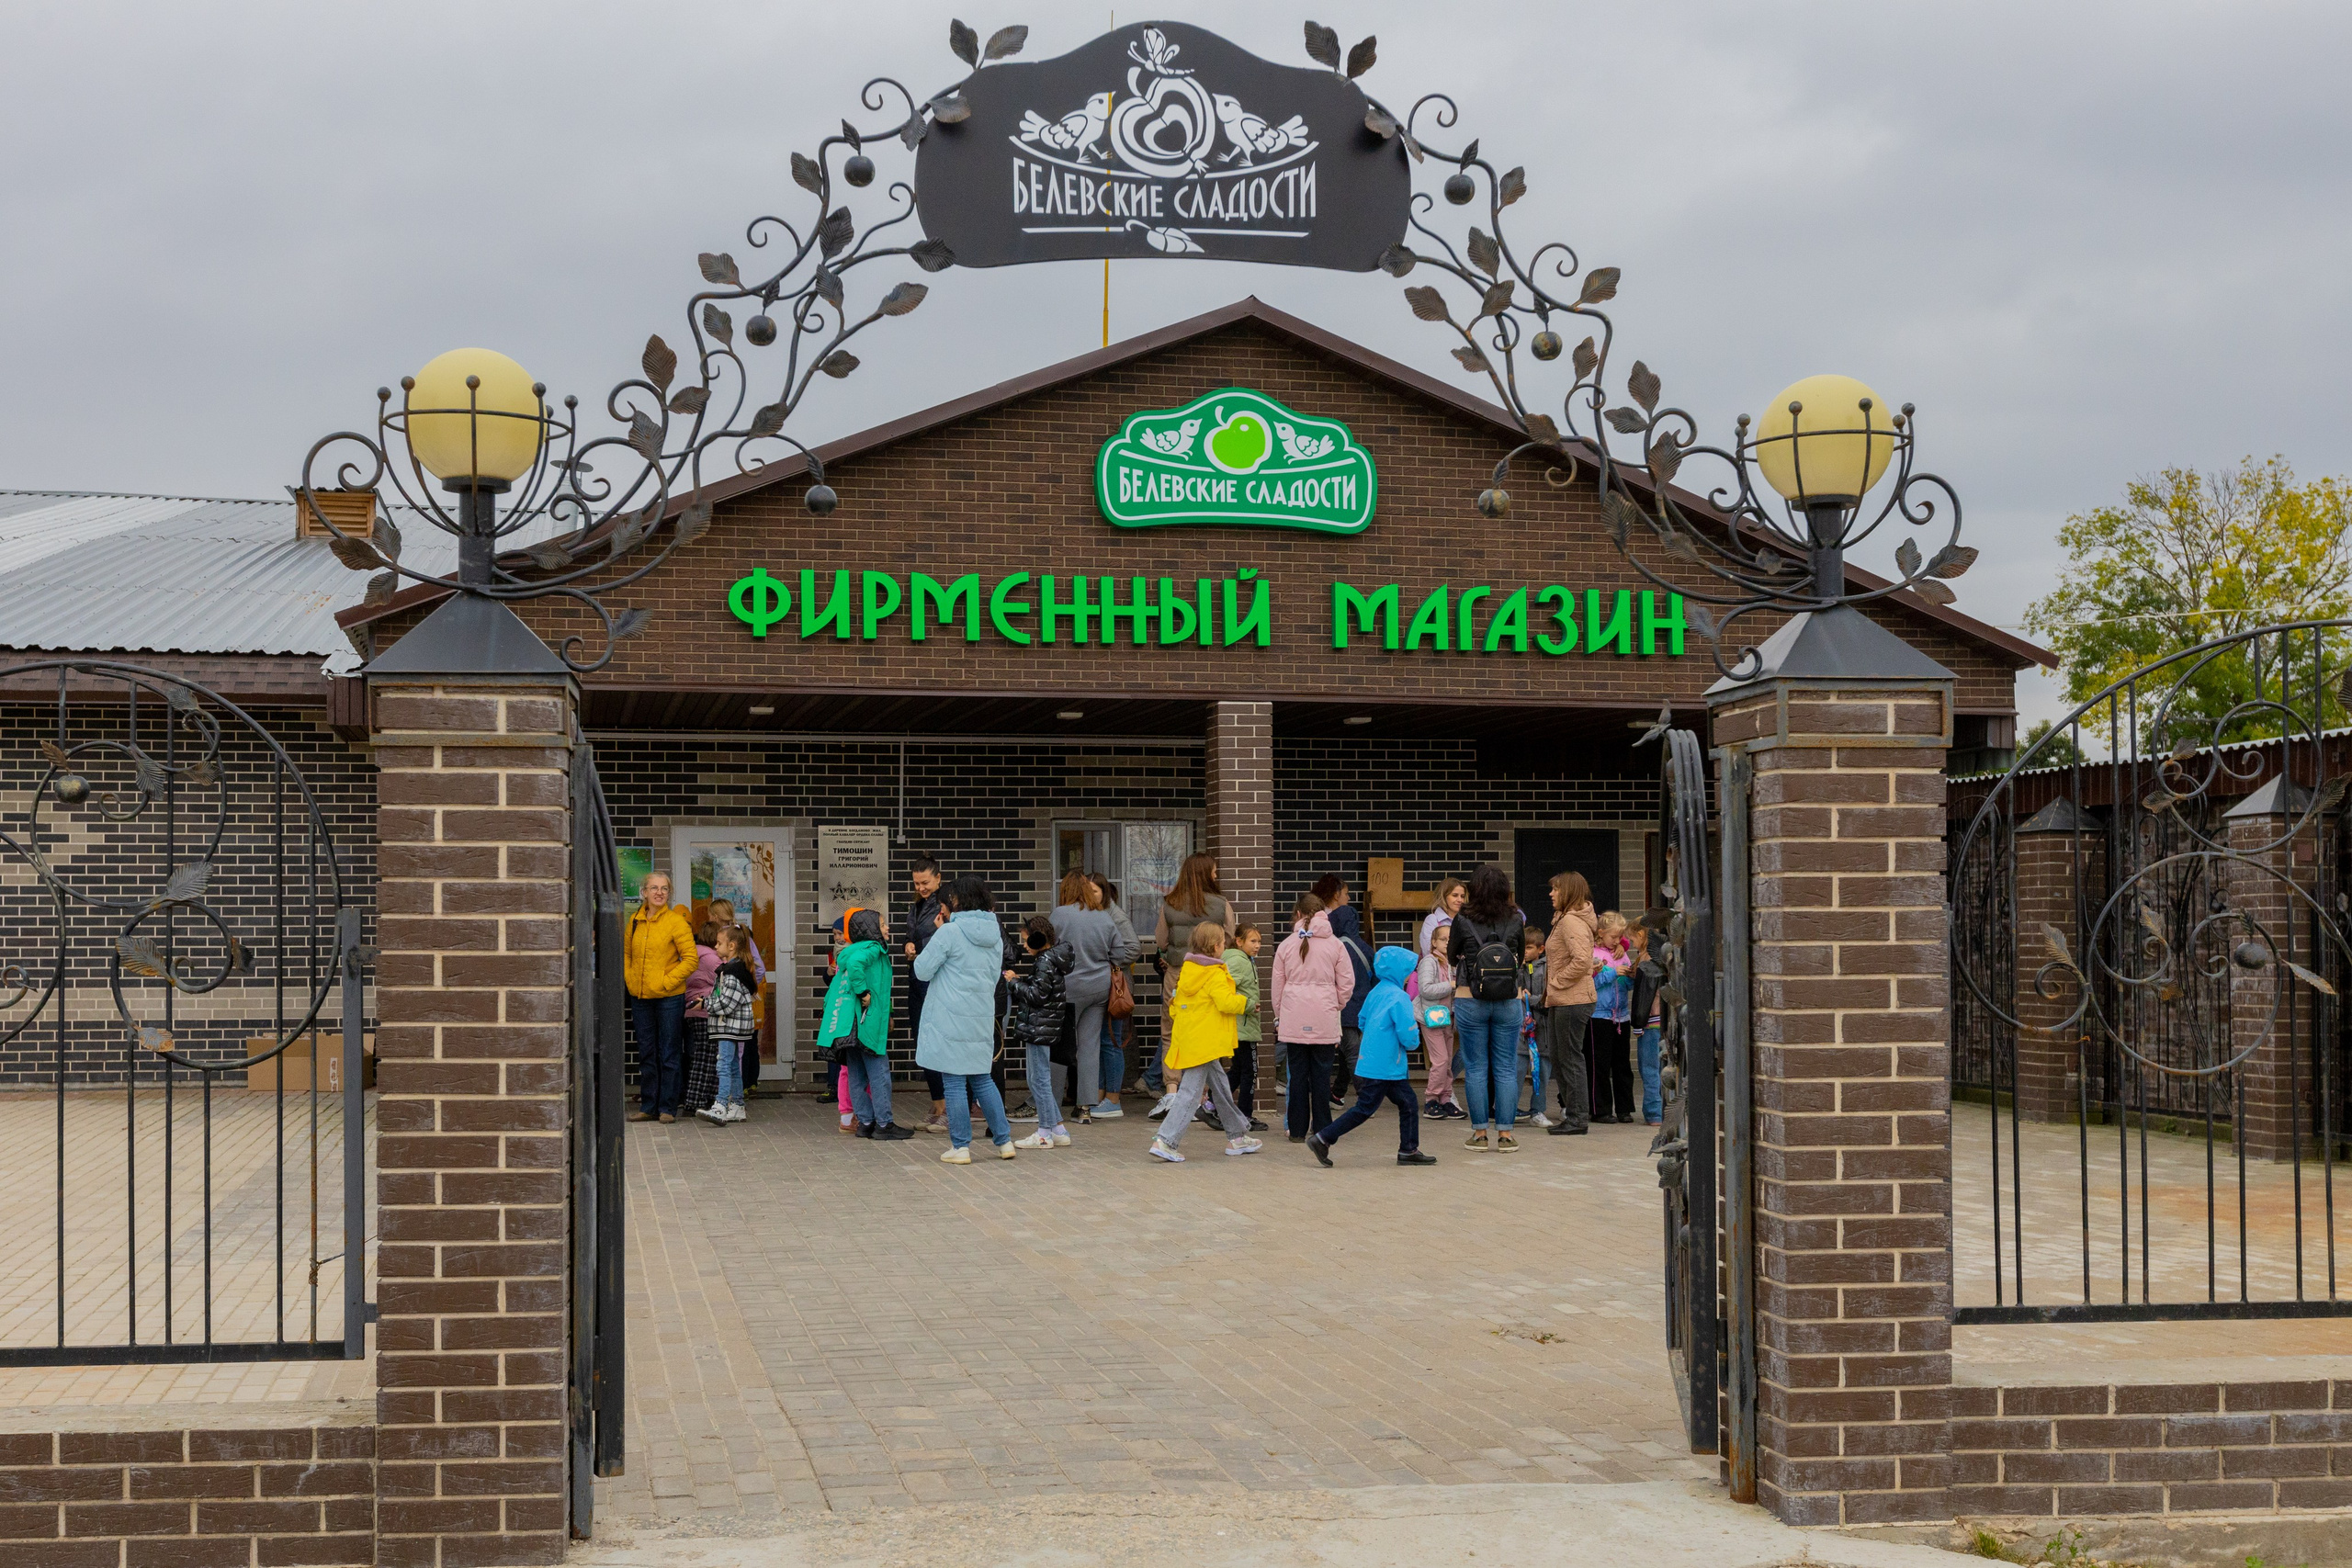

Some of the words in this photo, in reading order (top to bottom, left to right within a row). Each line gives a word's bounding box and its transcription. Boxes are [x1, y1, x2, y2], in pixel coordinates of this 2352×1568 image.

[1012, 156, 1164, 217] БЕЛЕВСКИЕ
[1173, 160, 1317, 221] СЛАДОСТИ
[1119, 466, 1238, 503] БЕЛЕВСКИЕ
[1245, 474, 1356, 511] СЛАДОСТИ
[728, 567, 1272, 647] ФИРМЕННЫЙ
[1331, 582, 1689, 656] МАГАЗИН
[1371, 872, 1388, 886] 100
